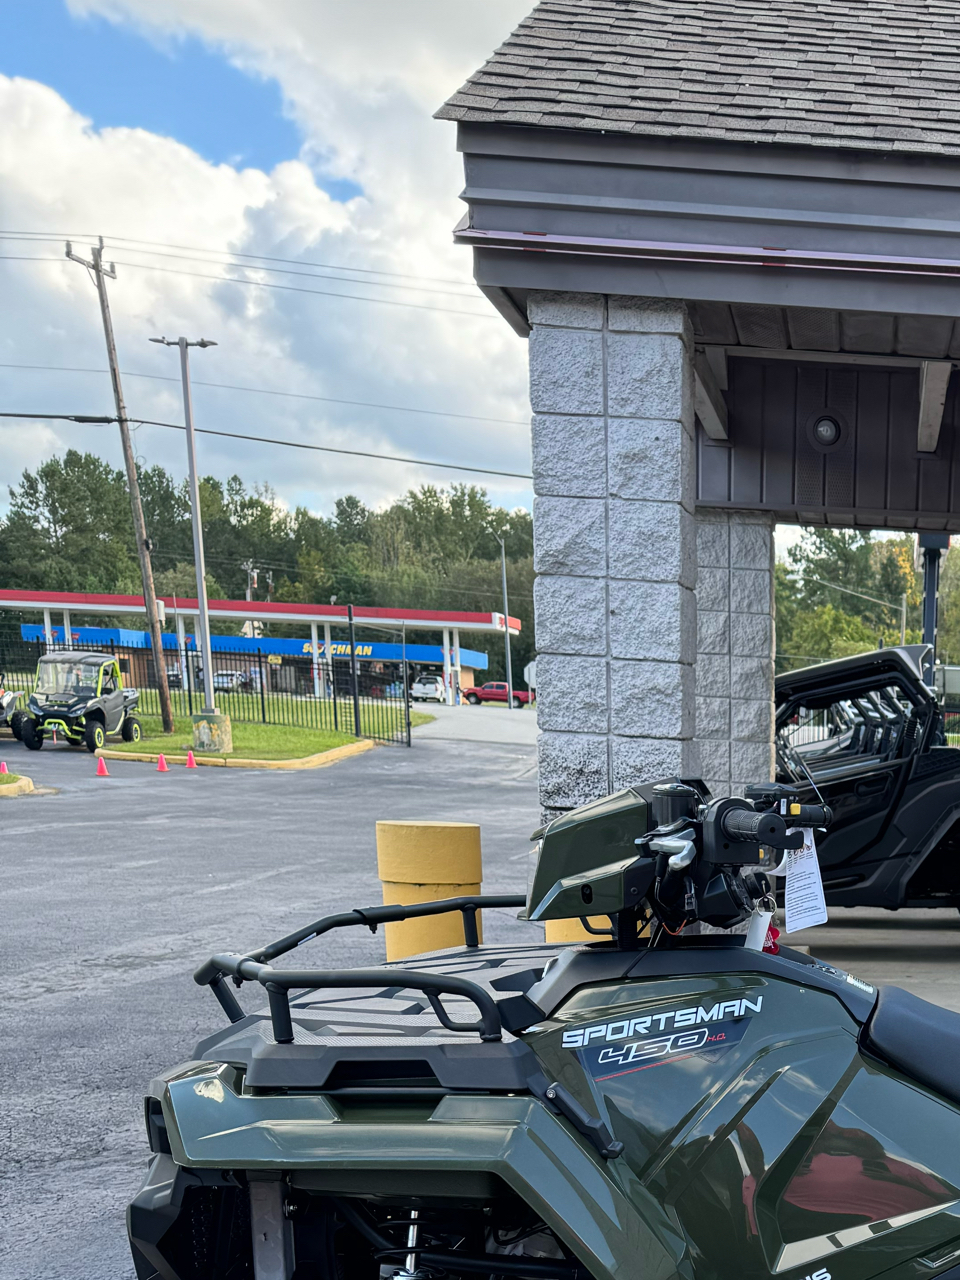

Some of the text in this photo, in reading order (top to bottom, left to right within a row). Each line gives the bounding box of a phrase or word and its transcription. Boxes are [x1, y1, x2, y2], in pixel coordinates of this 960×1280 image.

[302, 642, 373, 656] SCCHMAN
[561, 995, 763, 1049] SPORTSMAN
[598, 1028, 710, 1065] 450
